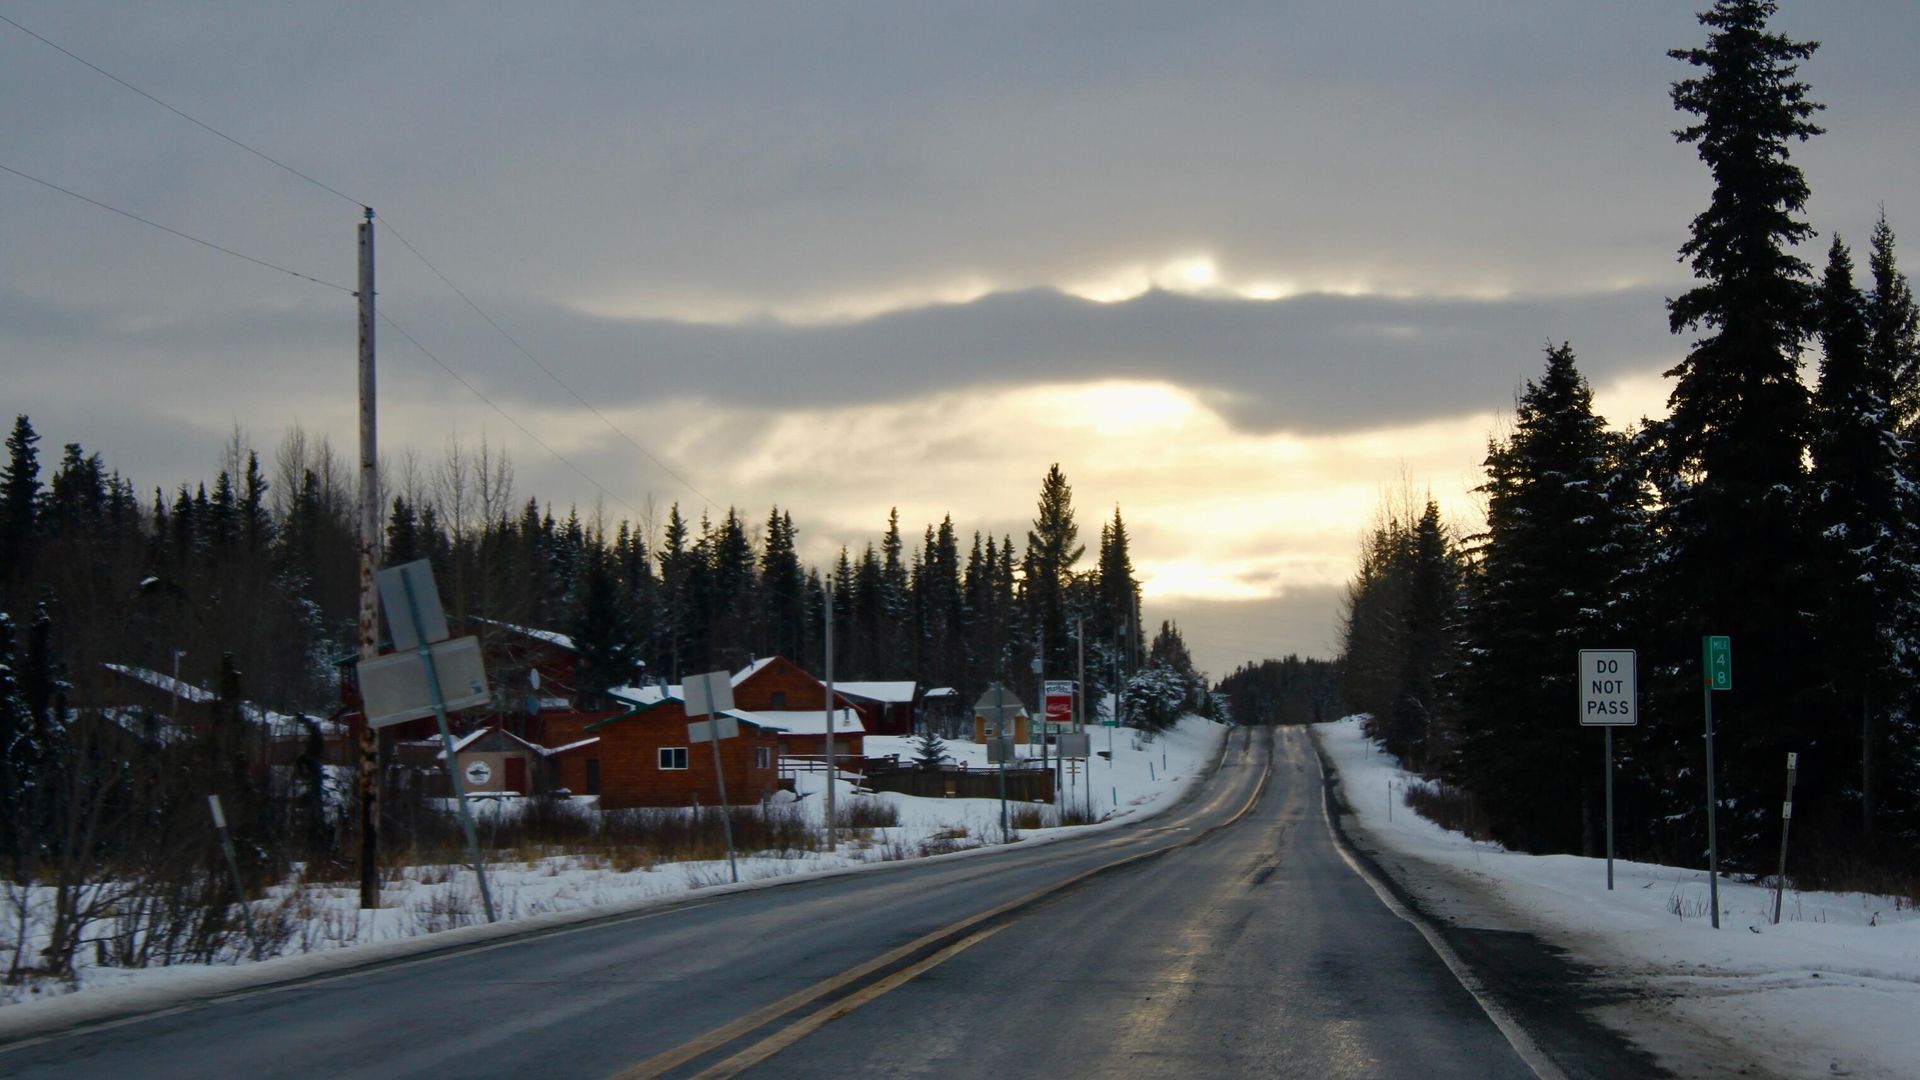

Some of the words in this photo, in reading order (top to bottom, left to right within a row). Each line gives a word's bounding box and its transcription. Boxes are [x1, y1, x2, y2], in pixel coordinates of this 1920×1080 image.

[1713, 640, 1728, 650] MILE
[1597, 659, 1618, 674] DO
[1716, 653, 1726, 667] 4
[1717, 671, 1727, 685] 8
[1592, 680, 1623, 694] NOT
[1587, 700, 1629, 715] PASS
